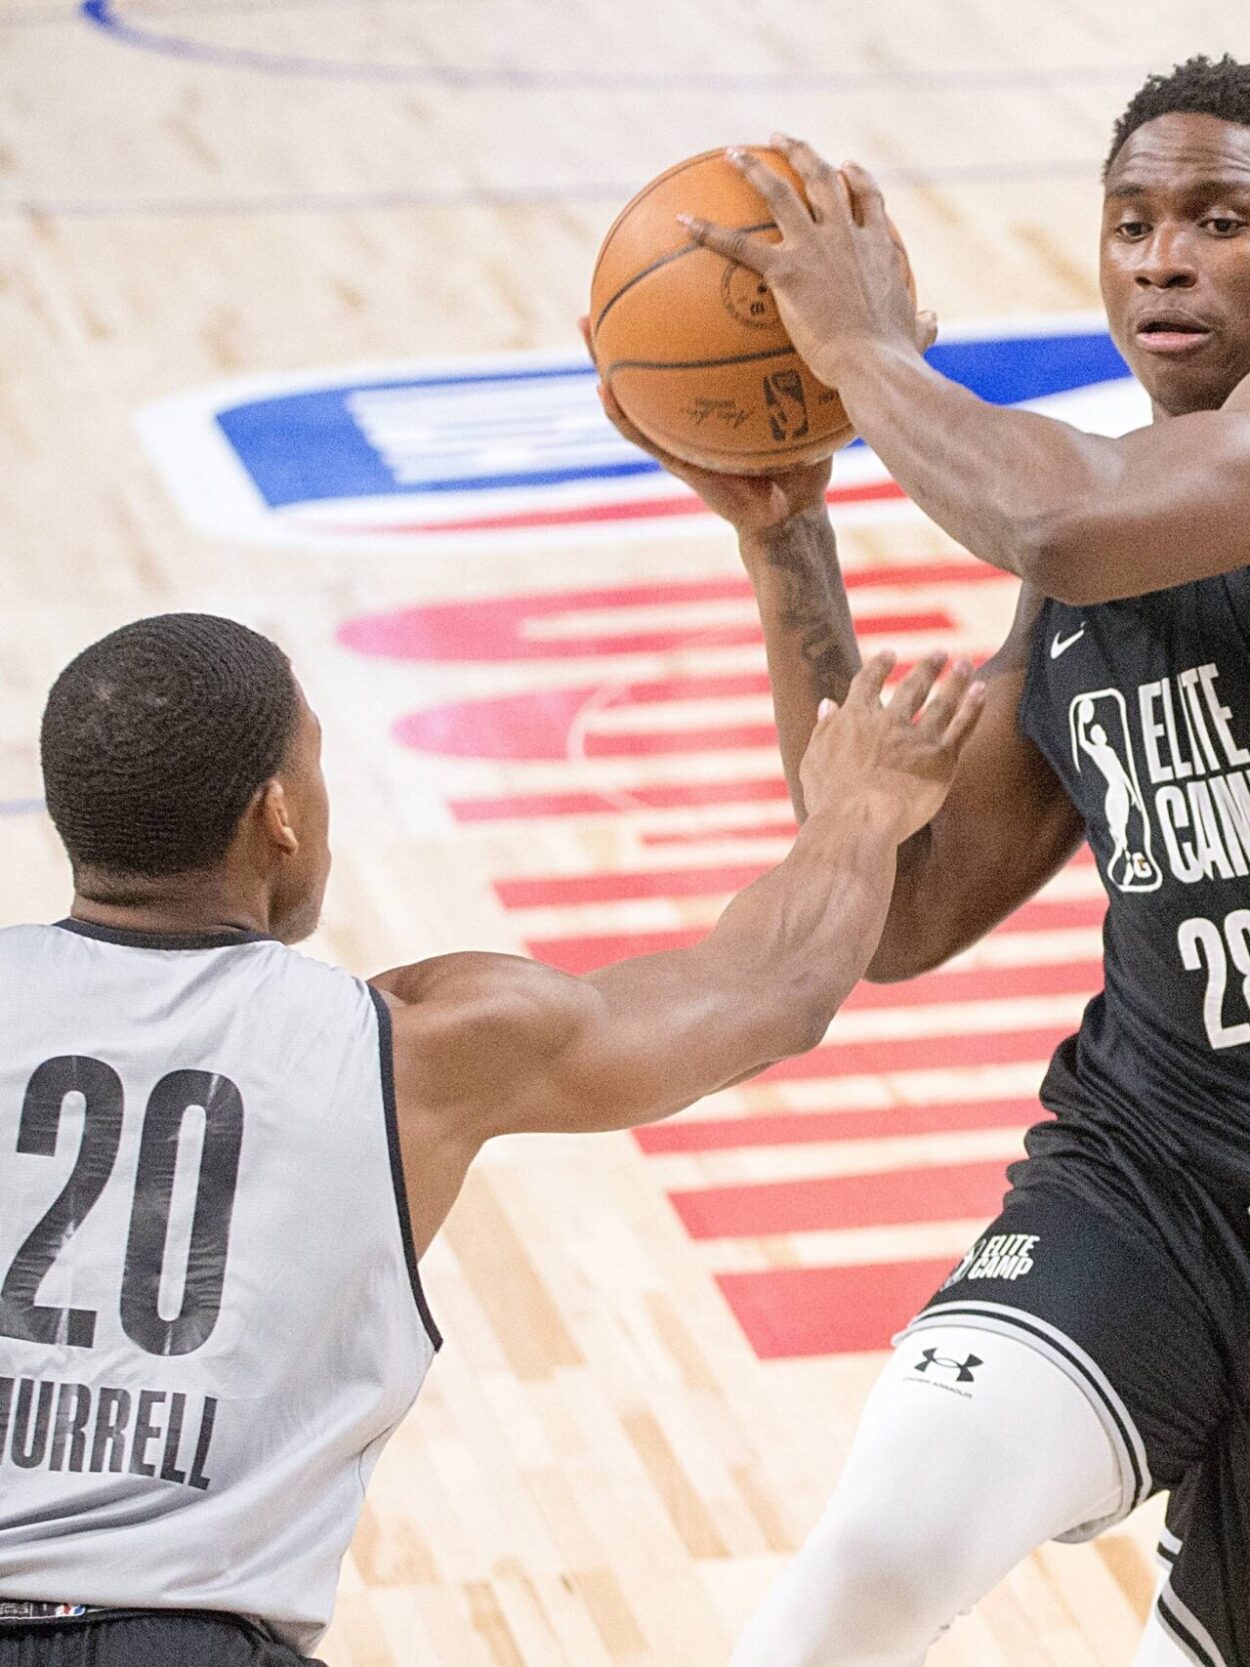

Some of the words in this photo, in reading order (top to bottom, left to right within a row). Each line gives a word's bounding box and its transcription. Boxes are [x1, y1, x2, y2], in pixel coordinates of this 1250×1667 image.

[0, 1054, 245, 1357] 20
[980, 1233, 1041, 1258] ELITE
[967, 1254, 1035, 1281] CAMP
